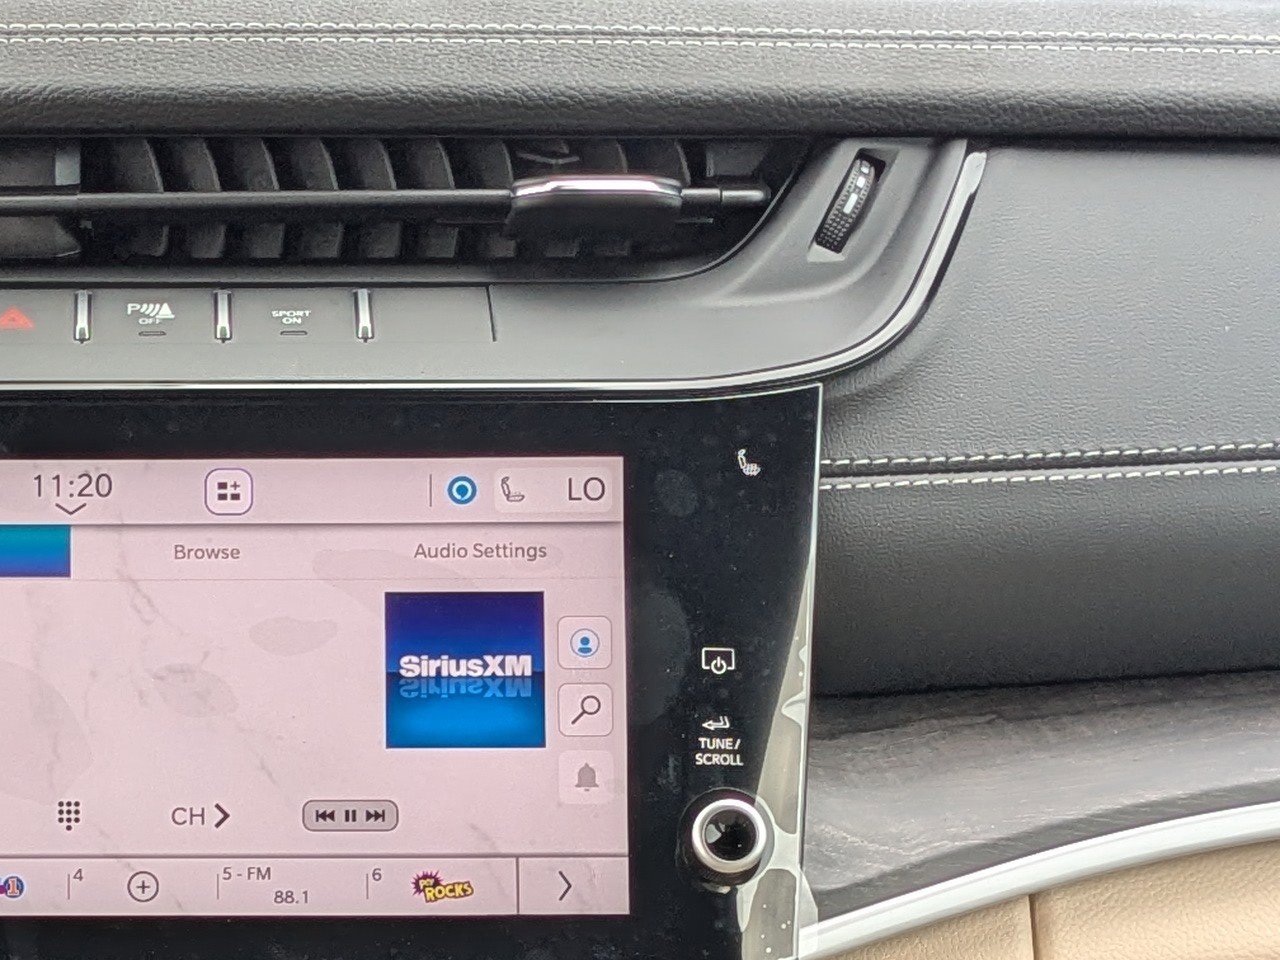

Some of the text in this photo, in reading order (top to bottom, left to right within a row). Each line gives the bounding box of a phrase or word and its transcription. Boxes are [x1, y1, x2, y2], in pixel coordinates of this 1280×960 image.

[271, 310, 312, 318] SPORT
[33, 473, 113, 498] 11:20
[568, 477, 606, 502] LO
[173, 544, 241, 561] Browse
[413, 542, 548, 562] Audio Settings
[399, 654, 533, 678] SiriusXM
[698, 737, 741, 750] TUNE/
[695, 753, 744, 766] SCROLL
[171, 807, 205, 826] CH
[73, 868, 84, 882] 4
[222, 868, 232, 881] 5
[247, 868, 272, 881] FM
[372, 868, 382, 882] 6
[274, 891, 310, 904] 88.1
[424, 882, 473, 902] ROCKS
